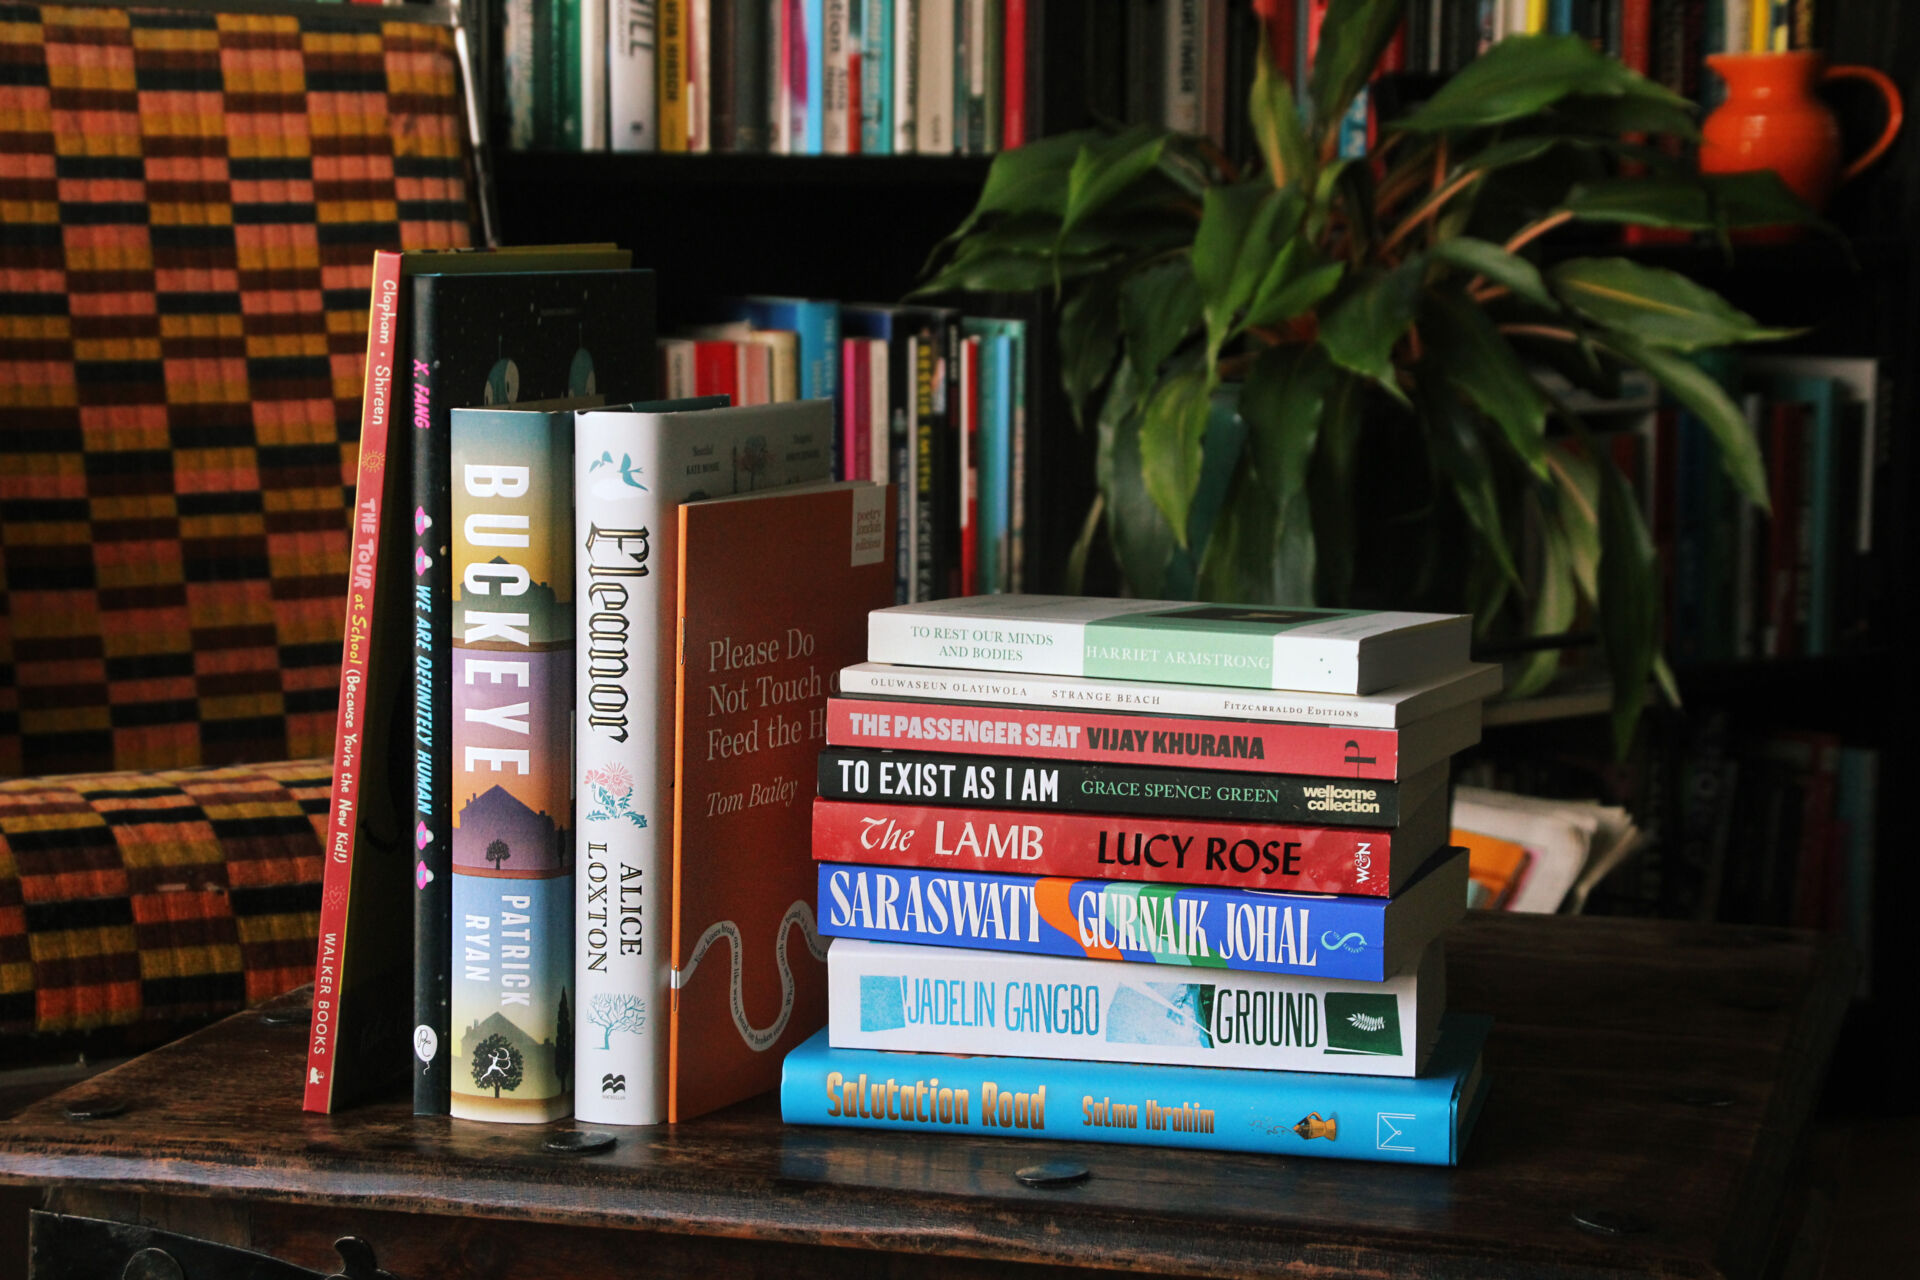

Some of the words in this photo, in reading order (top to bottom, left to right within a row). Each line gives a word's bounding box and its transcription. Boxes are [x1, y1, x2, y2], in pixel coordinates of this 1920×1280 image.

[379, 280, 396, 344] Clapham
[412, 359, 430, 378] X.
[372, 365, 391, 425] Shireen
[412, 385, 431, 429] FANG
[919, 424, 932, 493] SMITH
[360, 498, 376, 533] THE
[857, 508, 881, 522] poetry
[353, 594, 364, 610] at
[414, 585, 433, 616] WE
[464, 465, 531, 775] BUCKEYE
[349, 615, 367, 664] School
[414, 618, 433, 645] ARE
[586, 522, 650, 744] Eleanor
[710, 634, 779, 672] Please
[787, 629, 815, 660] Do
[910, 625, 929, 639] TO
[932, 627, 970, 641] REST
[973, 629, 1005, 643] OUR
[1008, 631, 1053, 647] MINDS
[939, 645, 968, 658] AND
[972, 647, 1023, 662] BODIES
[1086, 645, 1160, 663] HARRIET
[1165, 649, 1270, 669] ARMSTRONG
[343, 669, 364, 727] (Because
[415, 647, 433, 754] DEFINITELY
[709, 680, 749, 717] Not
[756, 666, 822, 707] Touch
[829, 671, 840, 692] o
[870, 678, 948, 691] OLUWASEUN
[952, 682, 1028, 697] OLAYIWOLA
[1052, 690, 1112, 702] STRANGE
[1116, 693, 1161, 704] BEACH
[343, 732, 358, 768] You're
[707, 720, 759, 761] Feed
[767, 715, 801, 747] the
[850, 712, 890, 737] THE
[894, 713, 1021, 745] PASSENGER
[1026, 722, 1081, 749] SEAT
[1086, 727, 1149, 755] VIJAY
[1153, 730, 1265, 760] KHURANA
[341, 768, 353, 793] the
[416, 757, 433, 815] HUMAN
[707, 792, 743, 817] Tom
[748, 776, 798, 809] Bailey
[838, 760, 869, 794] TO
[880, 761, 956, 797] EXIST
[963, 766, 992, 799] AS
[1006, 768, 1013, 800] I
[1021, 768, 1059, 802] AM
[1081, 779, 1141, 797] GRACE
[1145, 781, 1212, 800] SPENCE
[1217, 784, 1279, 804] GREEN
[1303, 785, 1377, 801] wellcome
[337, 799, 354, 828] New
[1307, 797, 1380, 814] collection
[332, 831, 350, 863] Kid!)
[860, 816, 915, 852] The
[935, 823, 1044, 861] LAMB
[1097, 831, 1193, 867] LUCY
[1205, 838, 1301, 876] ROSE
[1355, 842, 1371, 883] W&N
[588, 842, 607, 973] LOXTON
[620, 863, 643, 956] ALICE
[829, 869, 1041, 943] SARASWATI
[1077, 888, 1210, 961] GURNAIK
[1219, 900, 1318, 967] JOHAL
[320, 933, 336, 993] WALKER
[465, 915, 490, 982] RYAN
[501, 896, 531, 1007] PATRICK
[313, 999, 330, 1055] BOOKS
[906, 974, 996, 1030] JADELIN
[1005, 979, 1101, 1037] GANGBO
[1216, 987, 1319, 1048] GROUND
[827, 1071, 969, 1126] Salutation
[981, 1081, 1046, 1130] Road
[1082, 1095, 1138, 1129] Salma
[1145, 1099, 1216, 1135] Ibrahim
